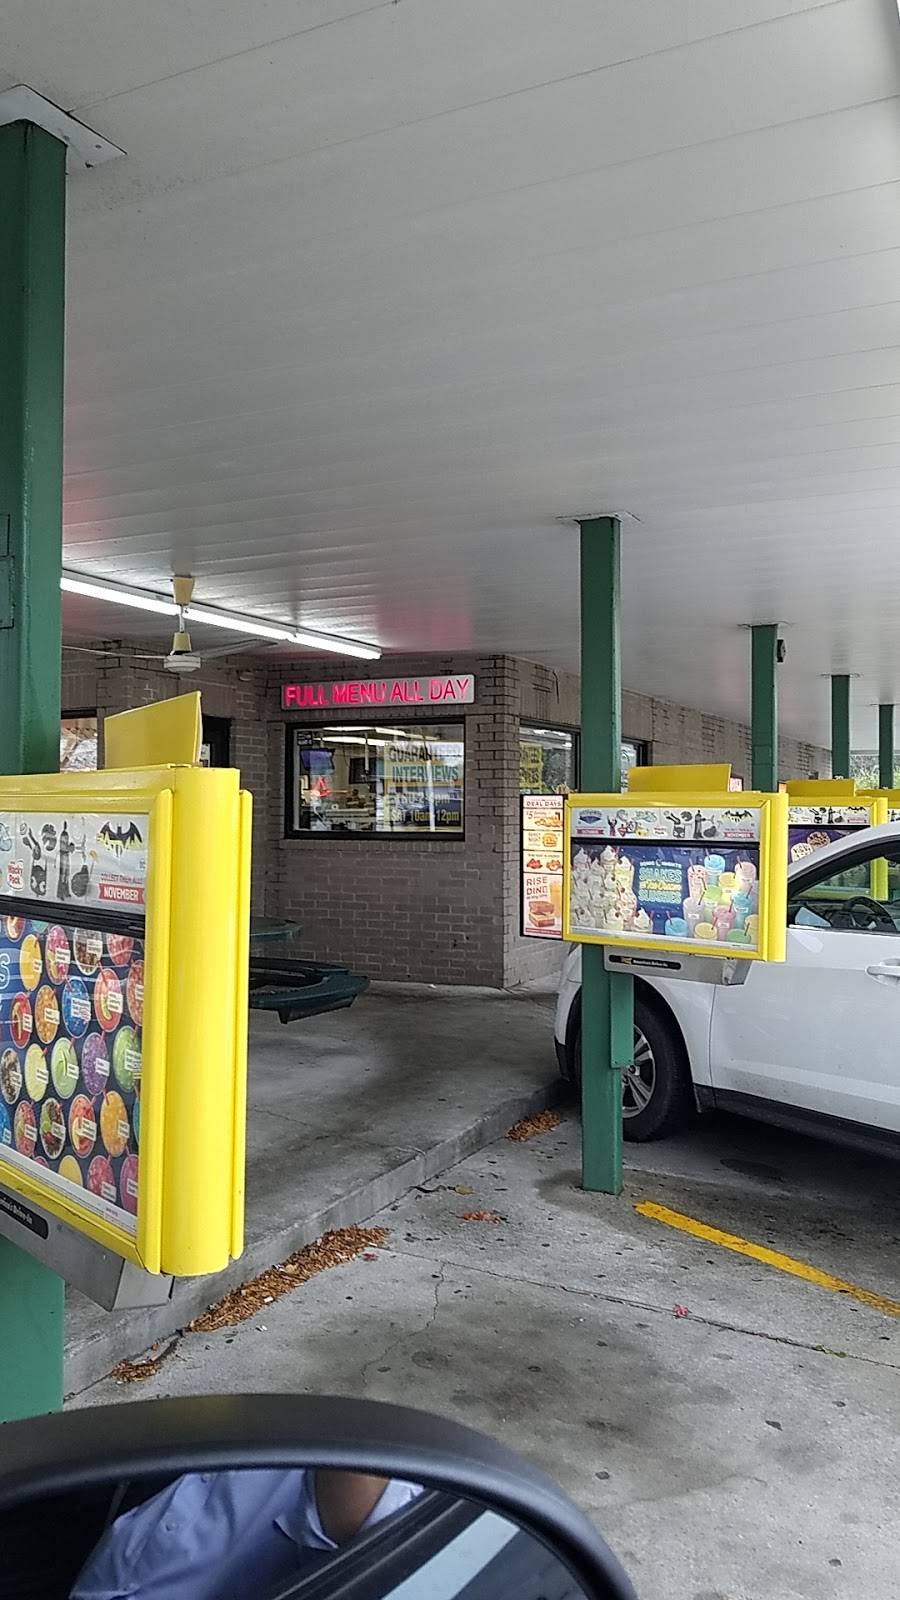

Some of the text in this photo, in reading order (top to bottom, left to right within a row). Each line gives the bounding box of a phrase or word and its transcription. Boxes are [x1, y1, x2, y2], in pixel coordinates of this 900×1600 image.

[285, 678, 469, 707] FULL MENU ALL DAY
[526, 876, 548, 886] RISE
[103, 886, 139, 901] NOVEMBER
